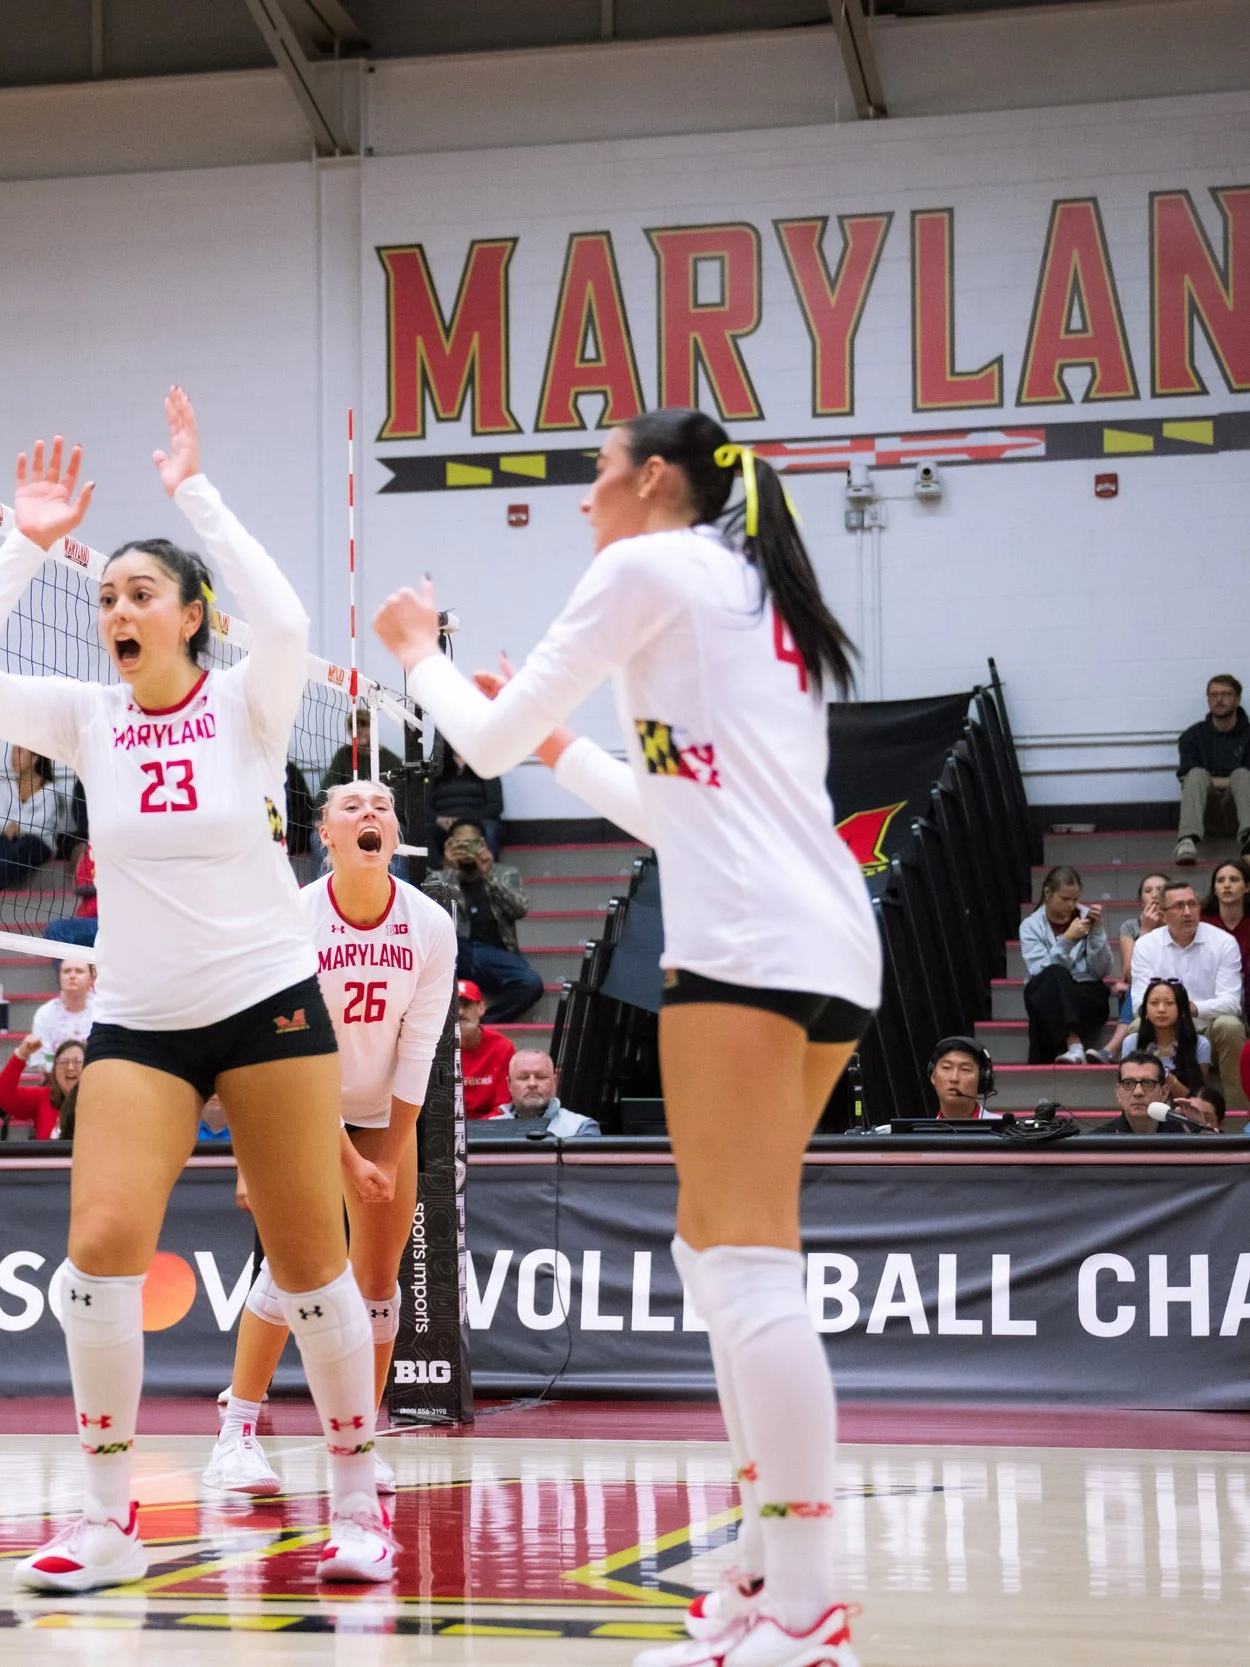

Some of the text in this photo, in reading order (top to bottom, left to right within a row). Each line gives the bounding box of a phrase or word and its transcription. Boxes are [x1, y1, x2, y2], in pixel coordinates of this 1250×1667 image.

[140, 758, 198, 813] 23
[317, 943, 413, 975] MARYLAND
[343, 981, 388, 1025] 26
[410, 1202, 431, 1333] sports imports
